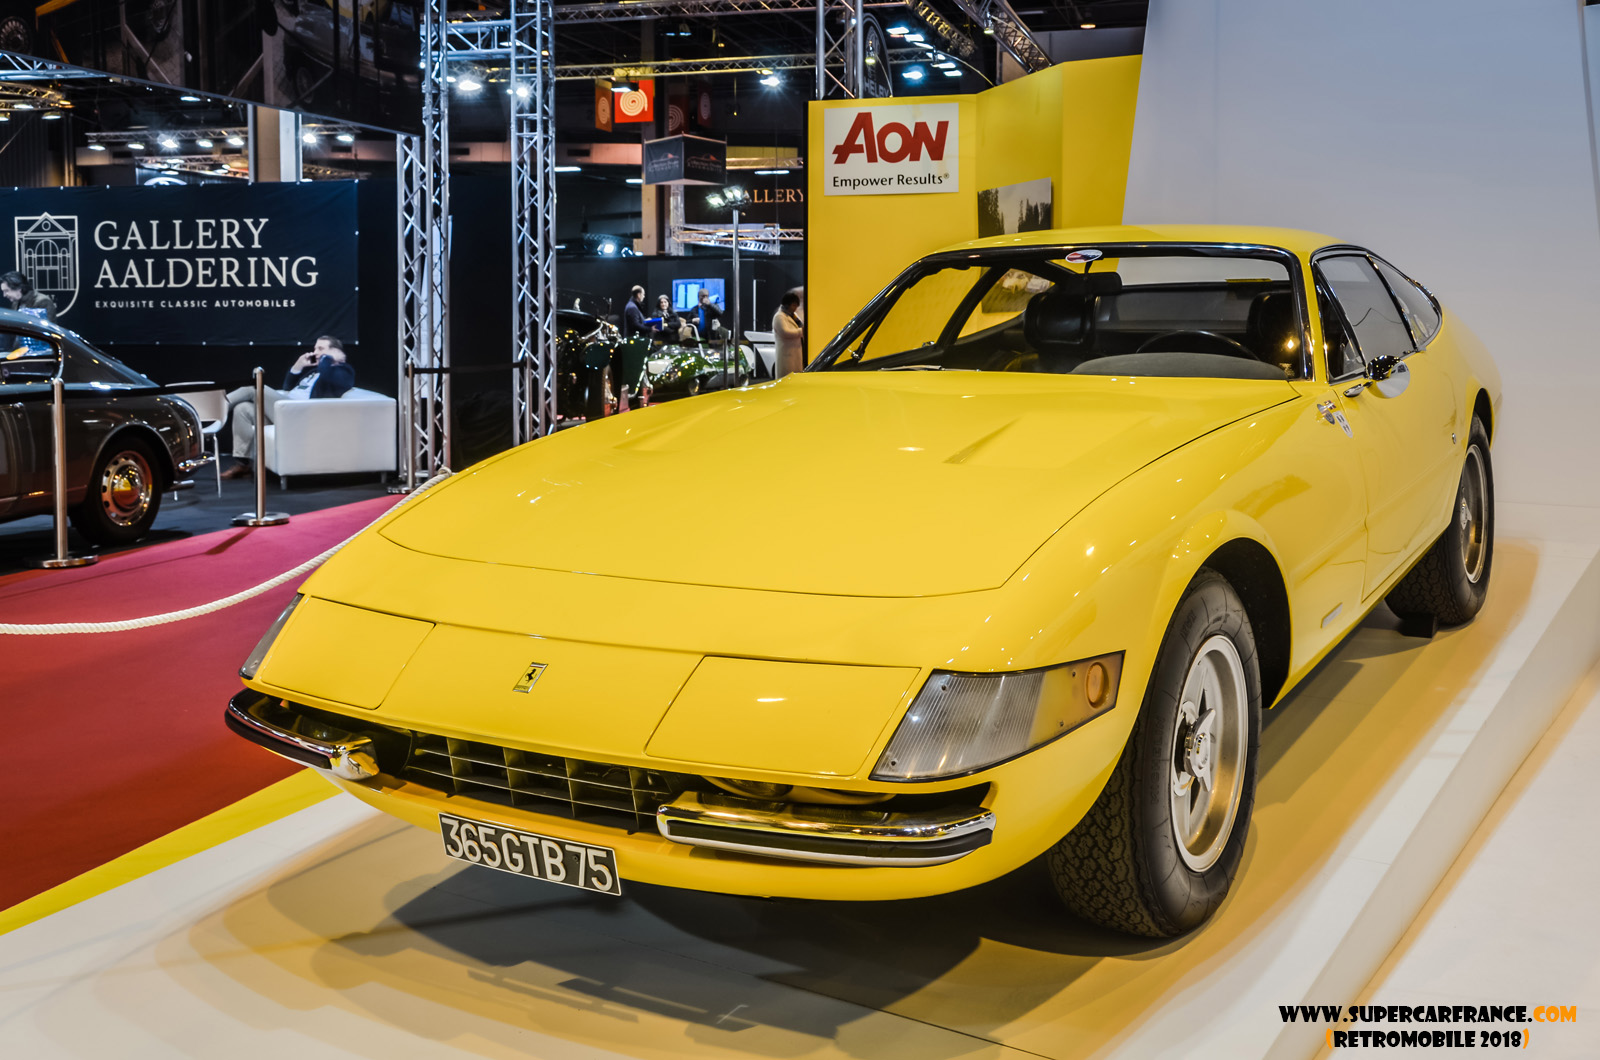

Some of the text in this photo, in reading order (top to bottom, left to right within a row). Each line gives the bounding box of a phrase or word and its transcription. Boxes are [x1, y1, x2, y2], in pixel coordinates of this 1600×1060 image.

[832, 112, 949, 164] AON
[833, 175, 894, 190] Empower
[742, 188, 804, 204] ALLERY
[94, 217, 269, 251] GALLERY
[94, 256, 319, 289] AALDERING
[95, 299, 296, 308] EXQUISITE CLASSIC AUTOMOBILES
